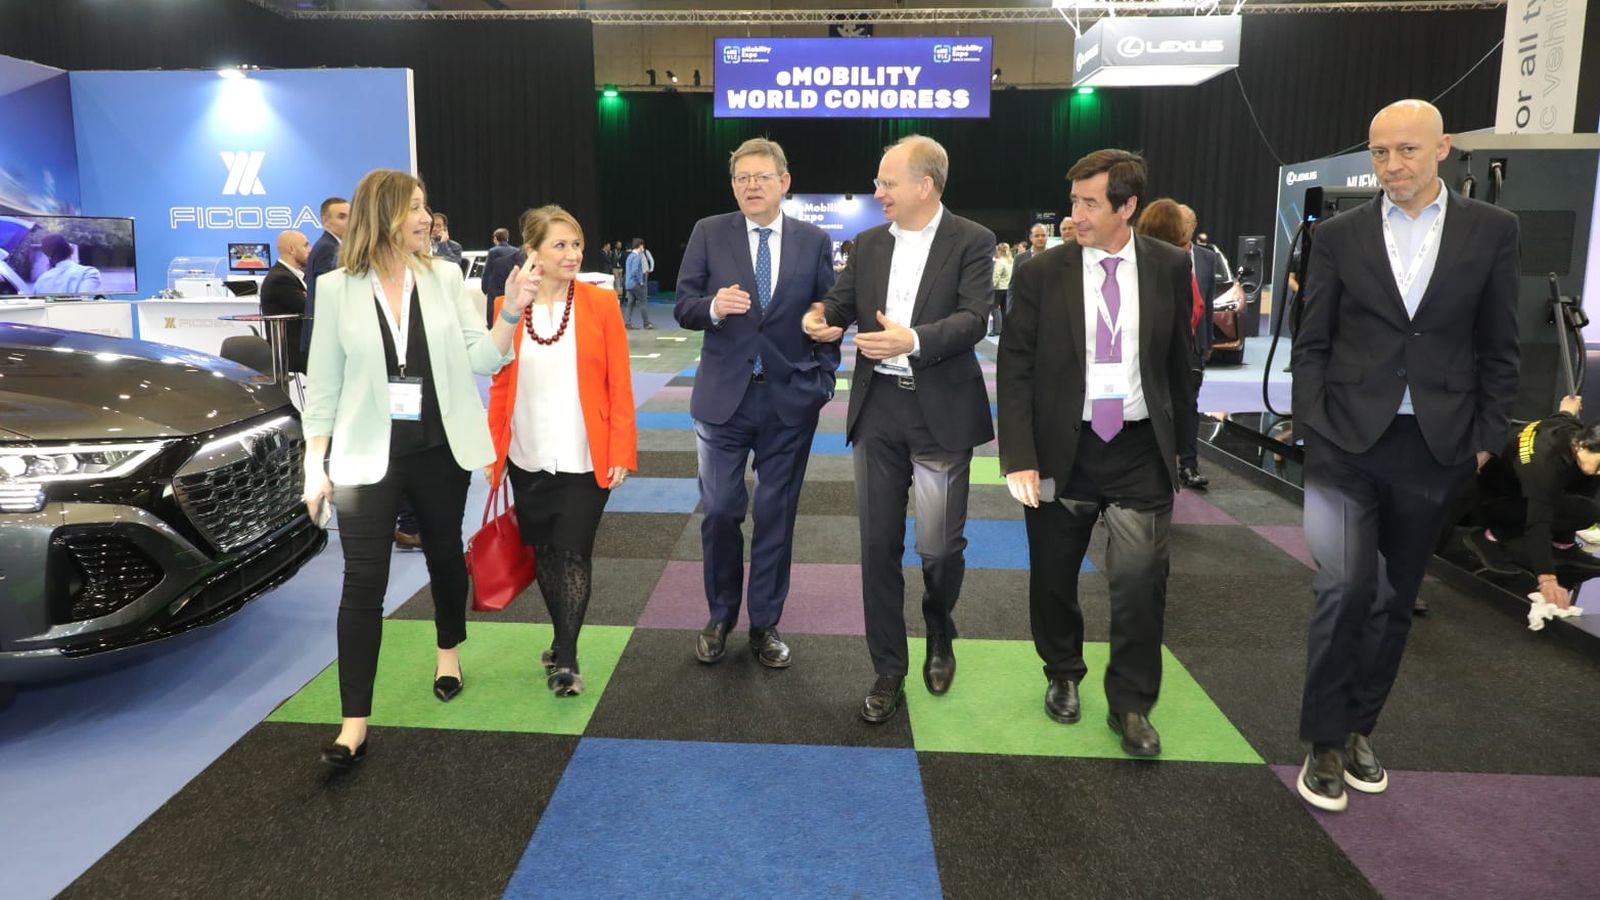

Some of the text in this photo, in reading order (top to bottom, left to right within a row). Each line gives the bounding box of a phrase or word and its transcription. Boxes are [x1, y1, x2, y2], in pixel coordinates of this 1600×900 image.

[1145, 40, 1224, 53] LEXUS
[1518, 33, 1538, 76] all
[776, 66, 922, 86] eMOBILITY
[727, 89, 970, 109] WORLD CONGRESS
[1510, 90, 1532, 135] or
[1540, 105, 1557, 135] c
[170, 205, 323, 229] FICOSA
[798, 212, 825, 224] Expo
